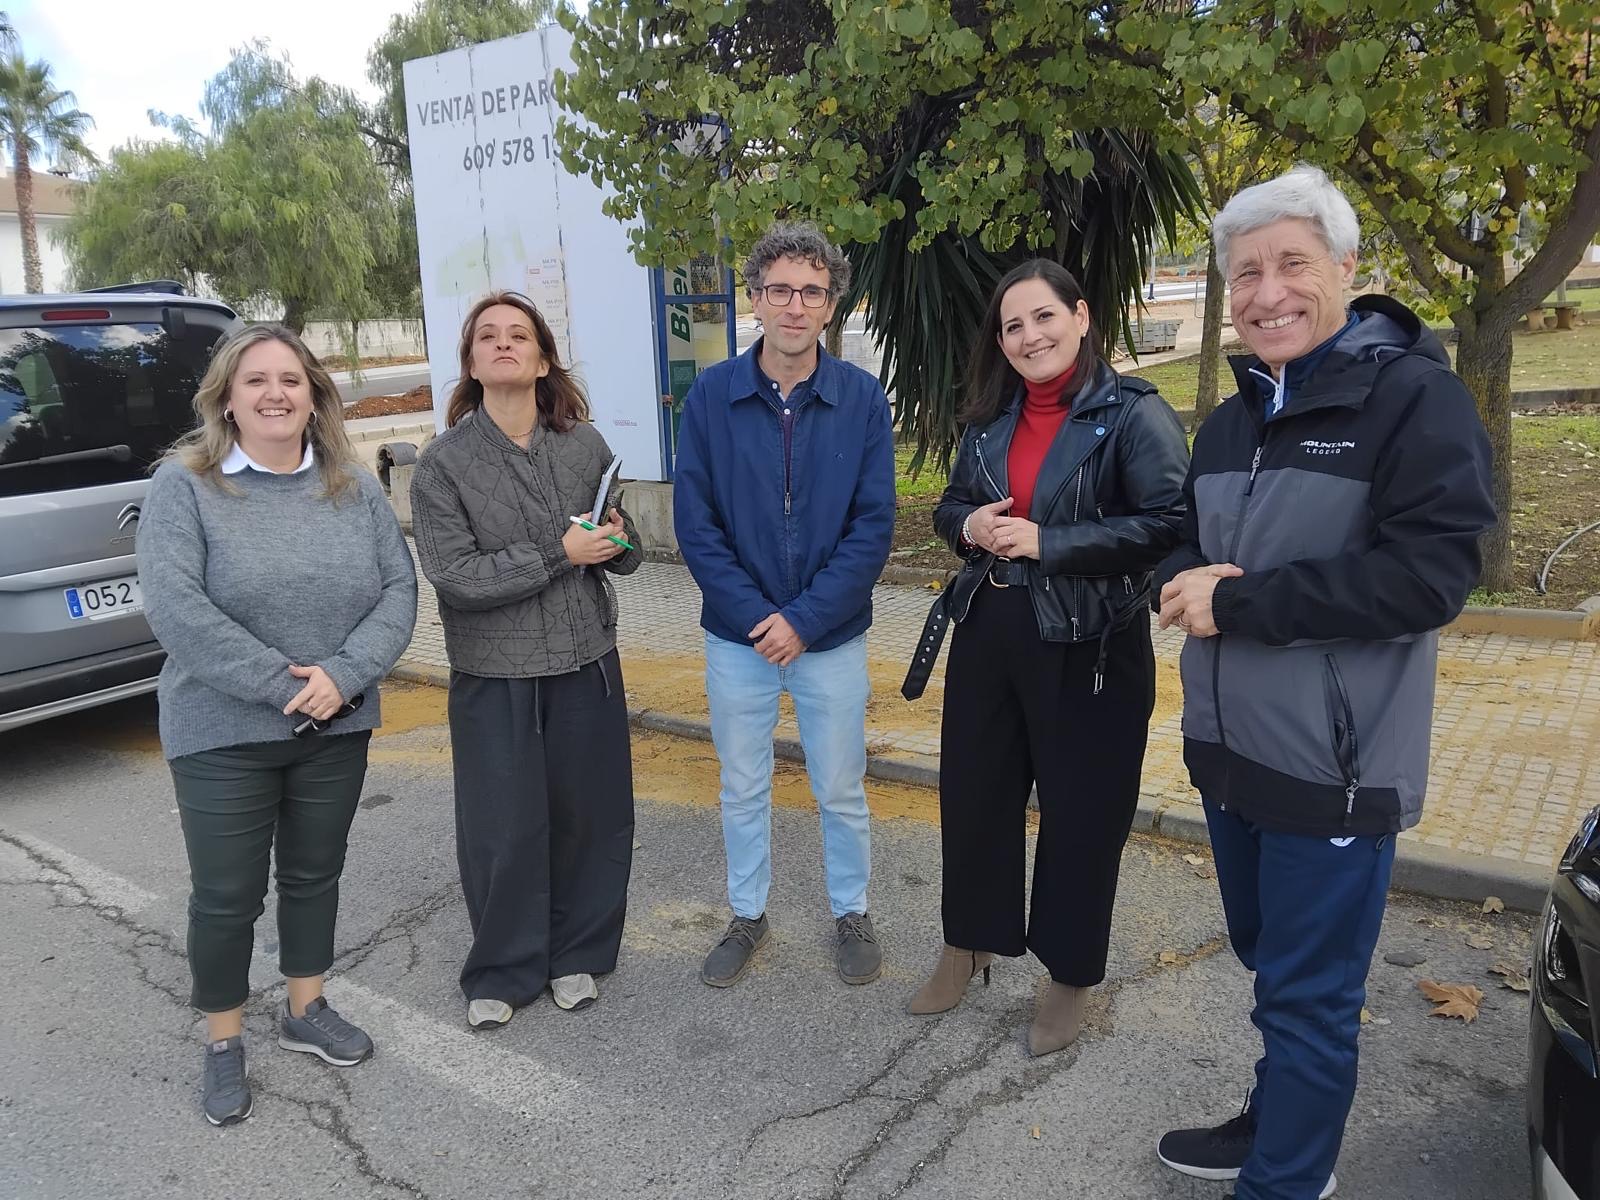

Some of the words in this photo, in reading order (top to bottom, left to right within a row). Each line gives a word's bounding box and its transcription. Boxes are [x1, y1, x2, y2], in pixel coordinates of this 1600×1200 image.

[417, 94, 474, 126] VENTA
[482, 88, 506, 116] DE
[463, 142, 494, 171] 609
[502, 136, 535, 166] 578
[1300, 440, 1355, 448] MOUNTAIN
[84, 580, 140, 610] 052
